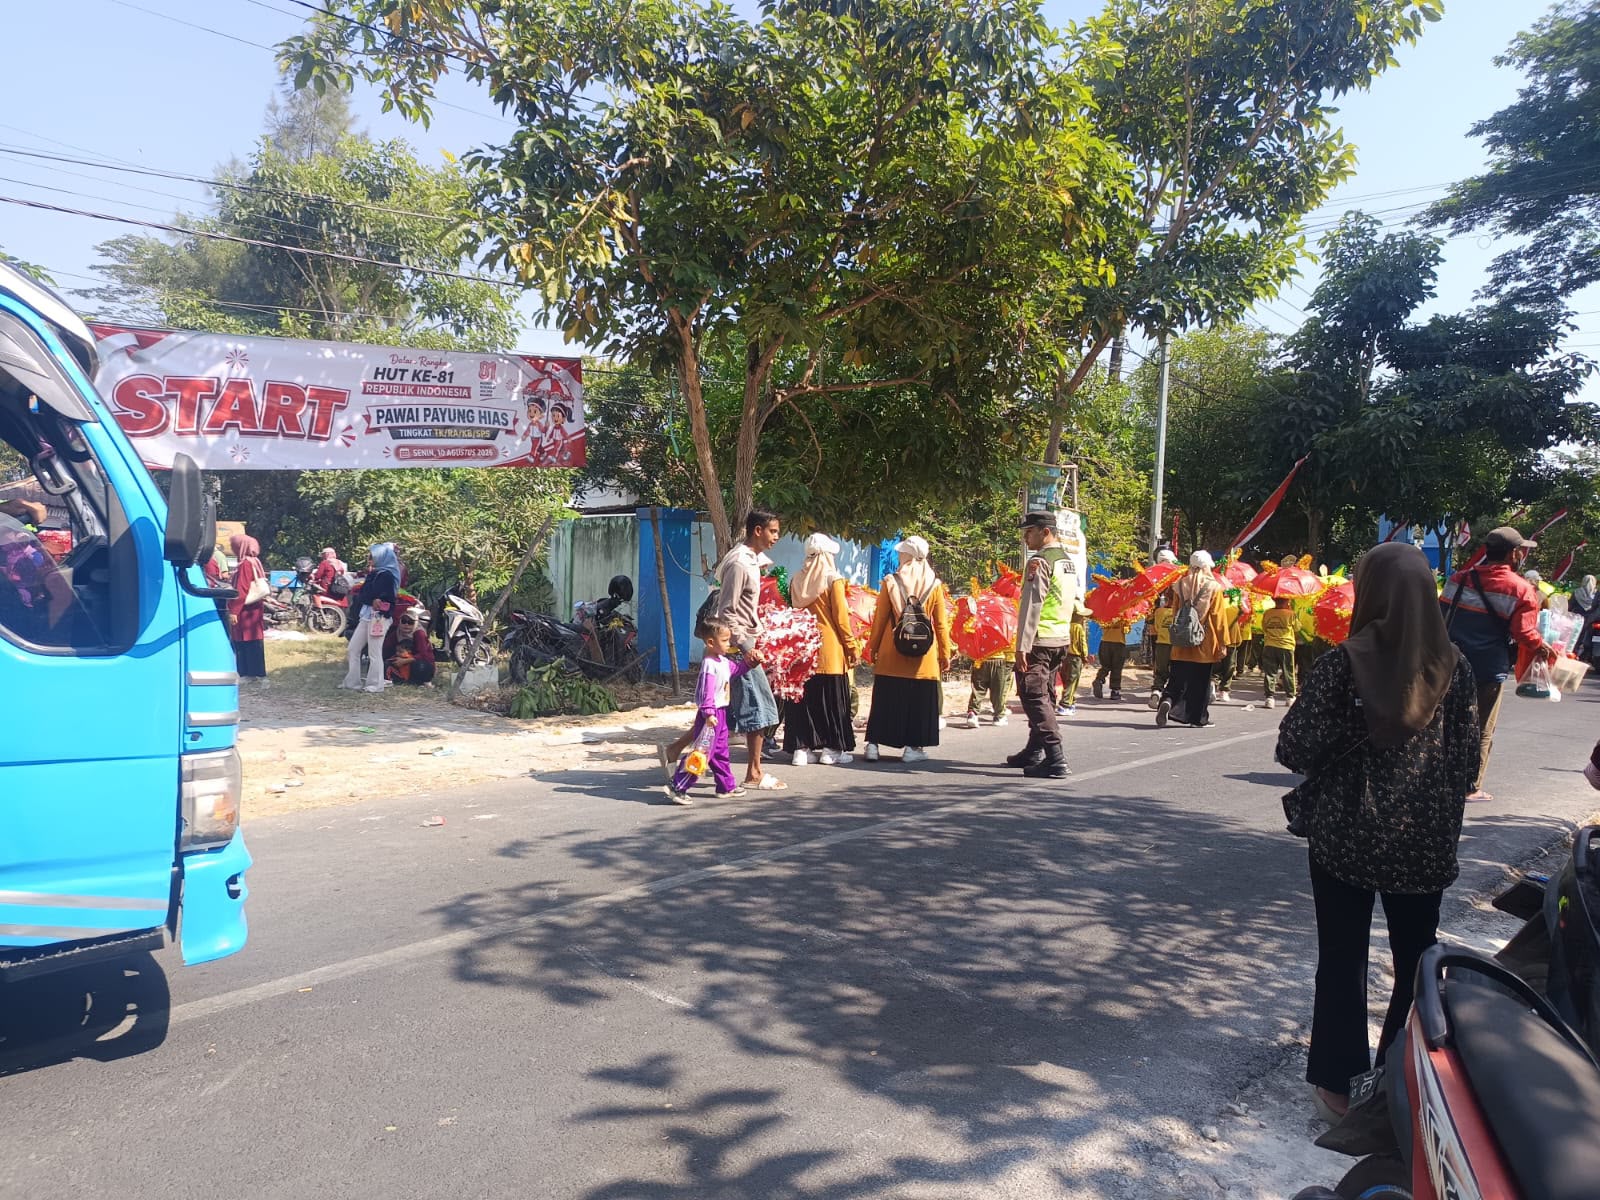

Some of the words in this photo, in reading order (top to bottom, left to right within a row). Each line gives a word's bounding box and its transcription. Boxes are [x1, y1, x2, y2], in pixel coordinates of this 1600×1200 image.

[373, 367, 408, 381] HUT
[411, 369, 454, 384] KE-81
[366, 384, 414, 396] REPUBLIK
[416, 385, 469, 398] INDONESIA
[113, 373, 351, 441] START
[376, 407, 420, 425] PAWAI
[423, 407, 475, 425] PAYUNG
[478, 409, 509, 427] HIAS
[399, 428, 432, 437] TINGKAT
[412, 448, 436, 457] SENIN,
[446, 448, 476, 457] AGUSTUS
